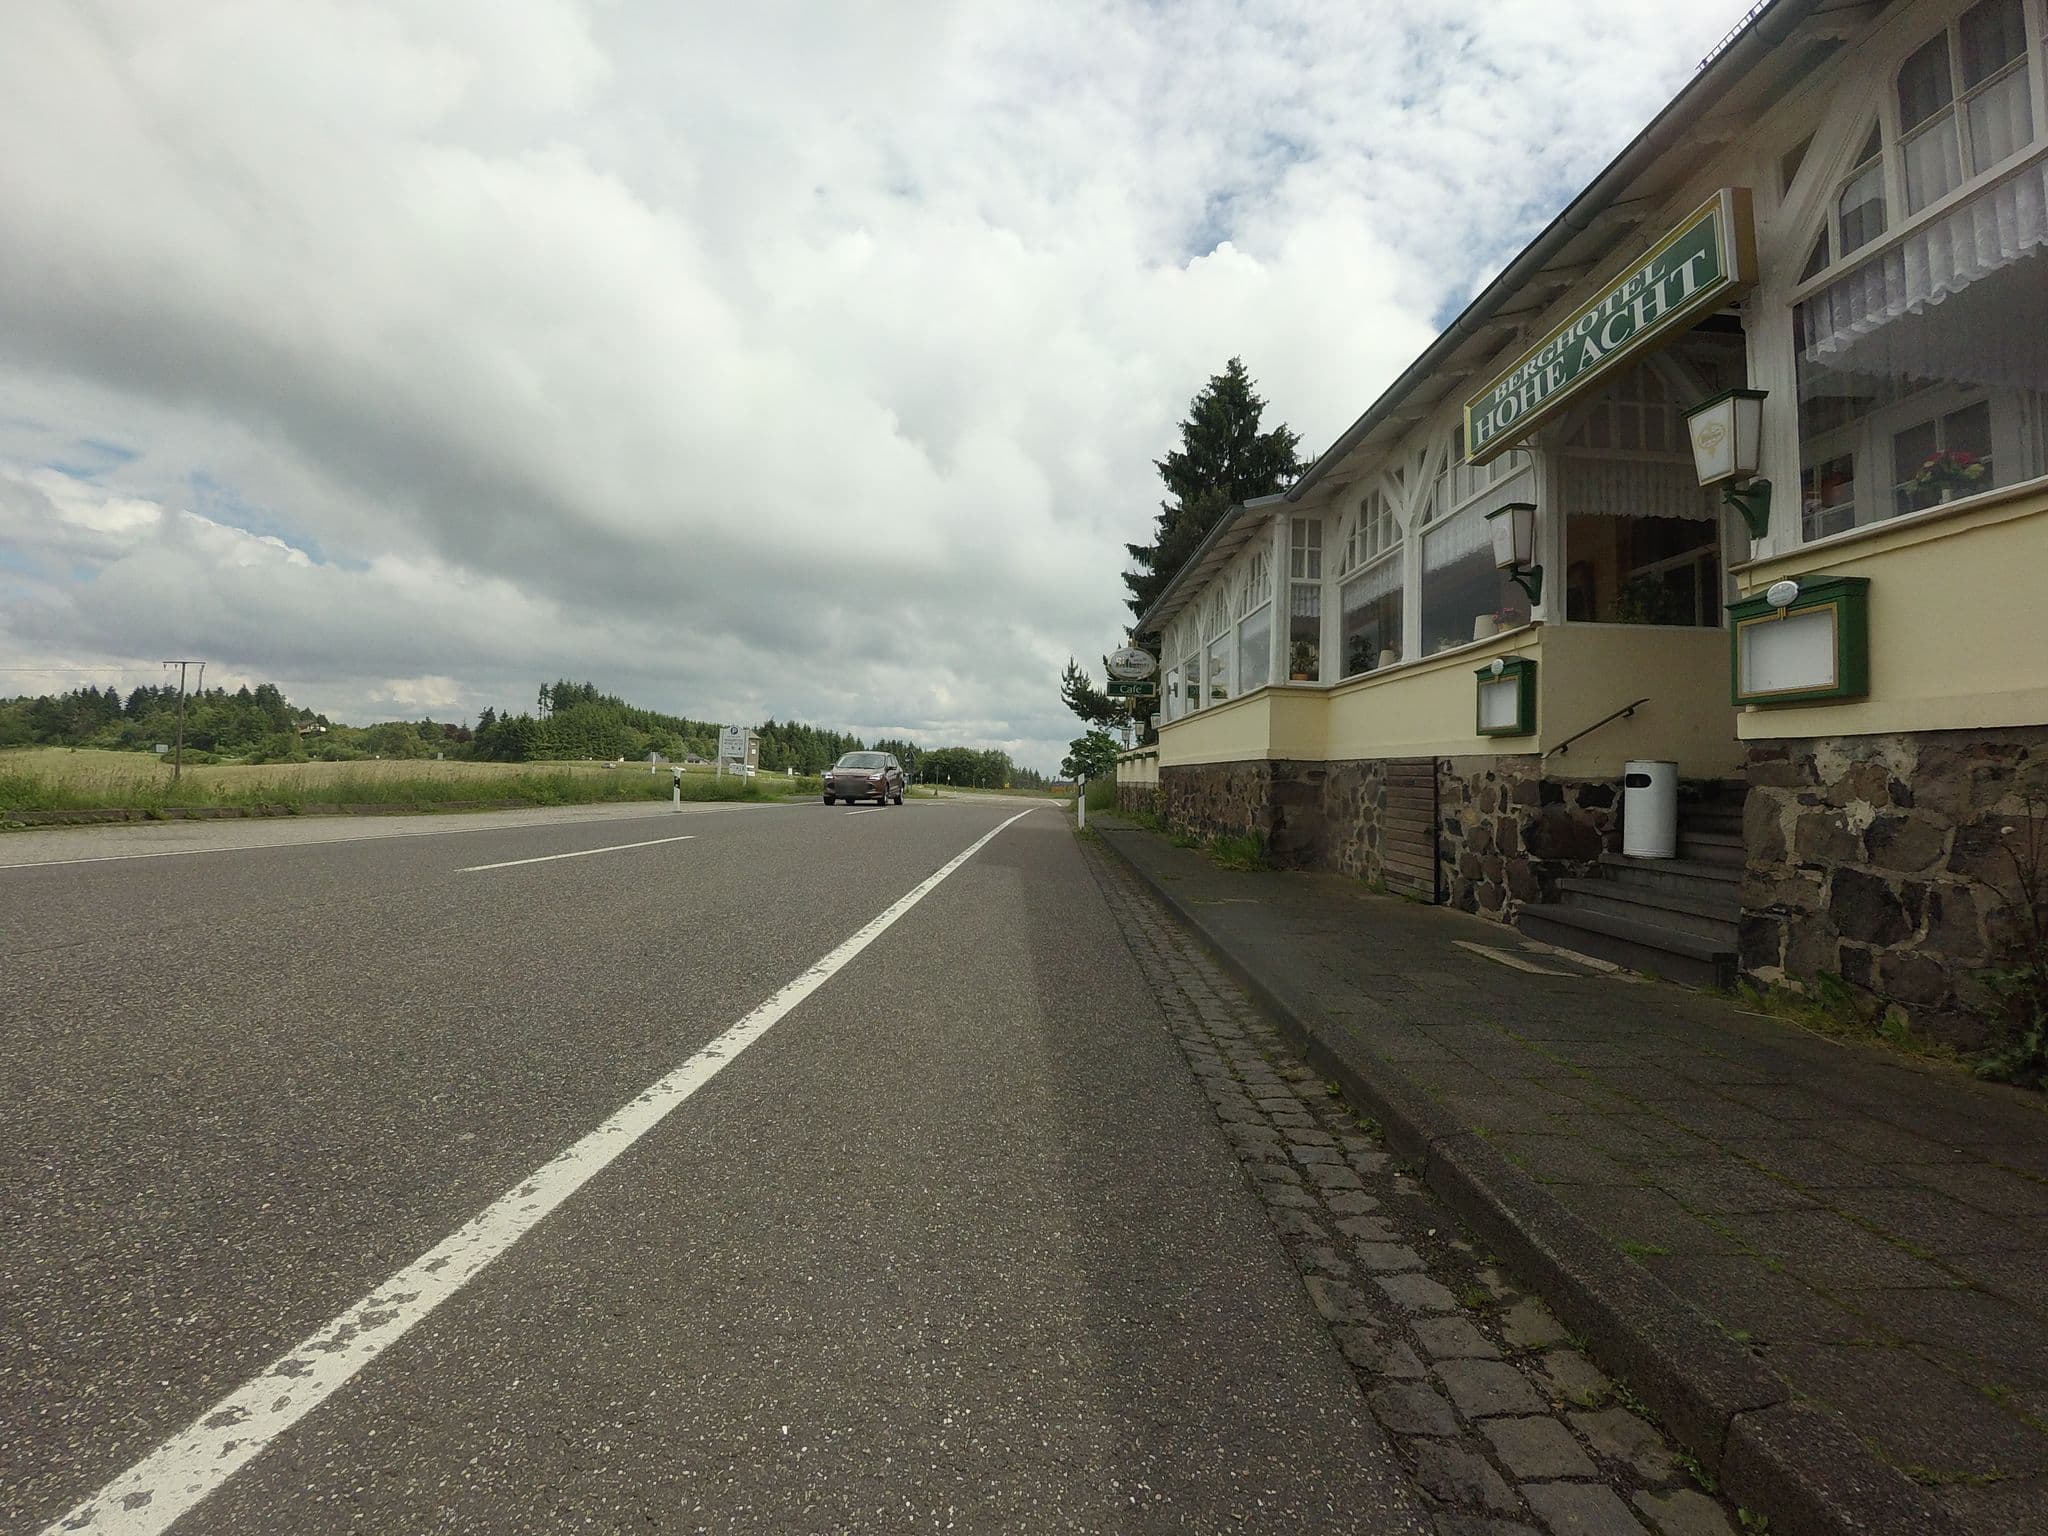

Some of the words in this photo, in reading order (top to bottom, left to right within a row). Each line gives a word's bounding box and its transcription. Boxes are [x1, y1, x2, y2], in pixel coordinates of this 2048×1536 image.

[1475, 355, 1567, 447] HOHE
[1576, 248, 1706, 373] ACHT
[1493, 262, 1667, 403] BERGHOTEL
